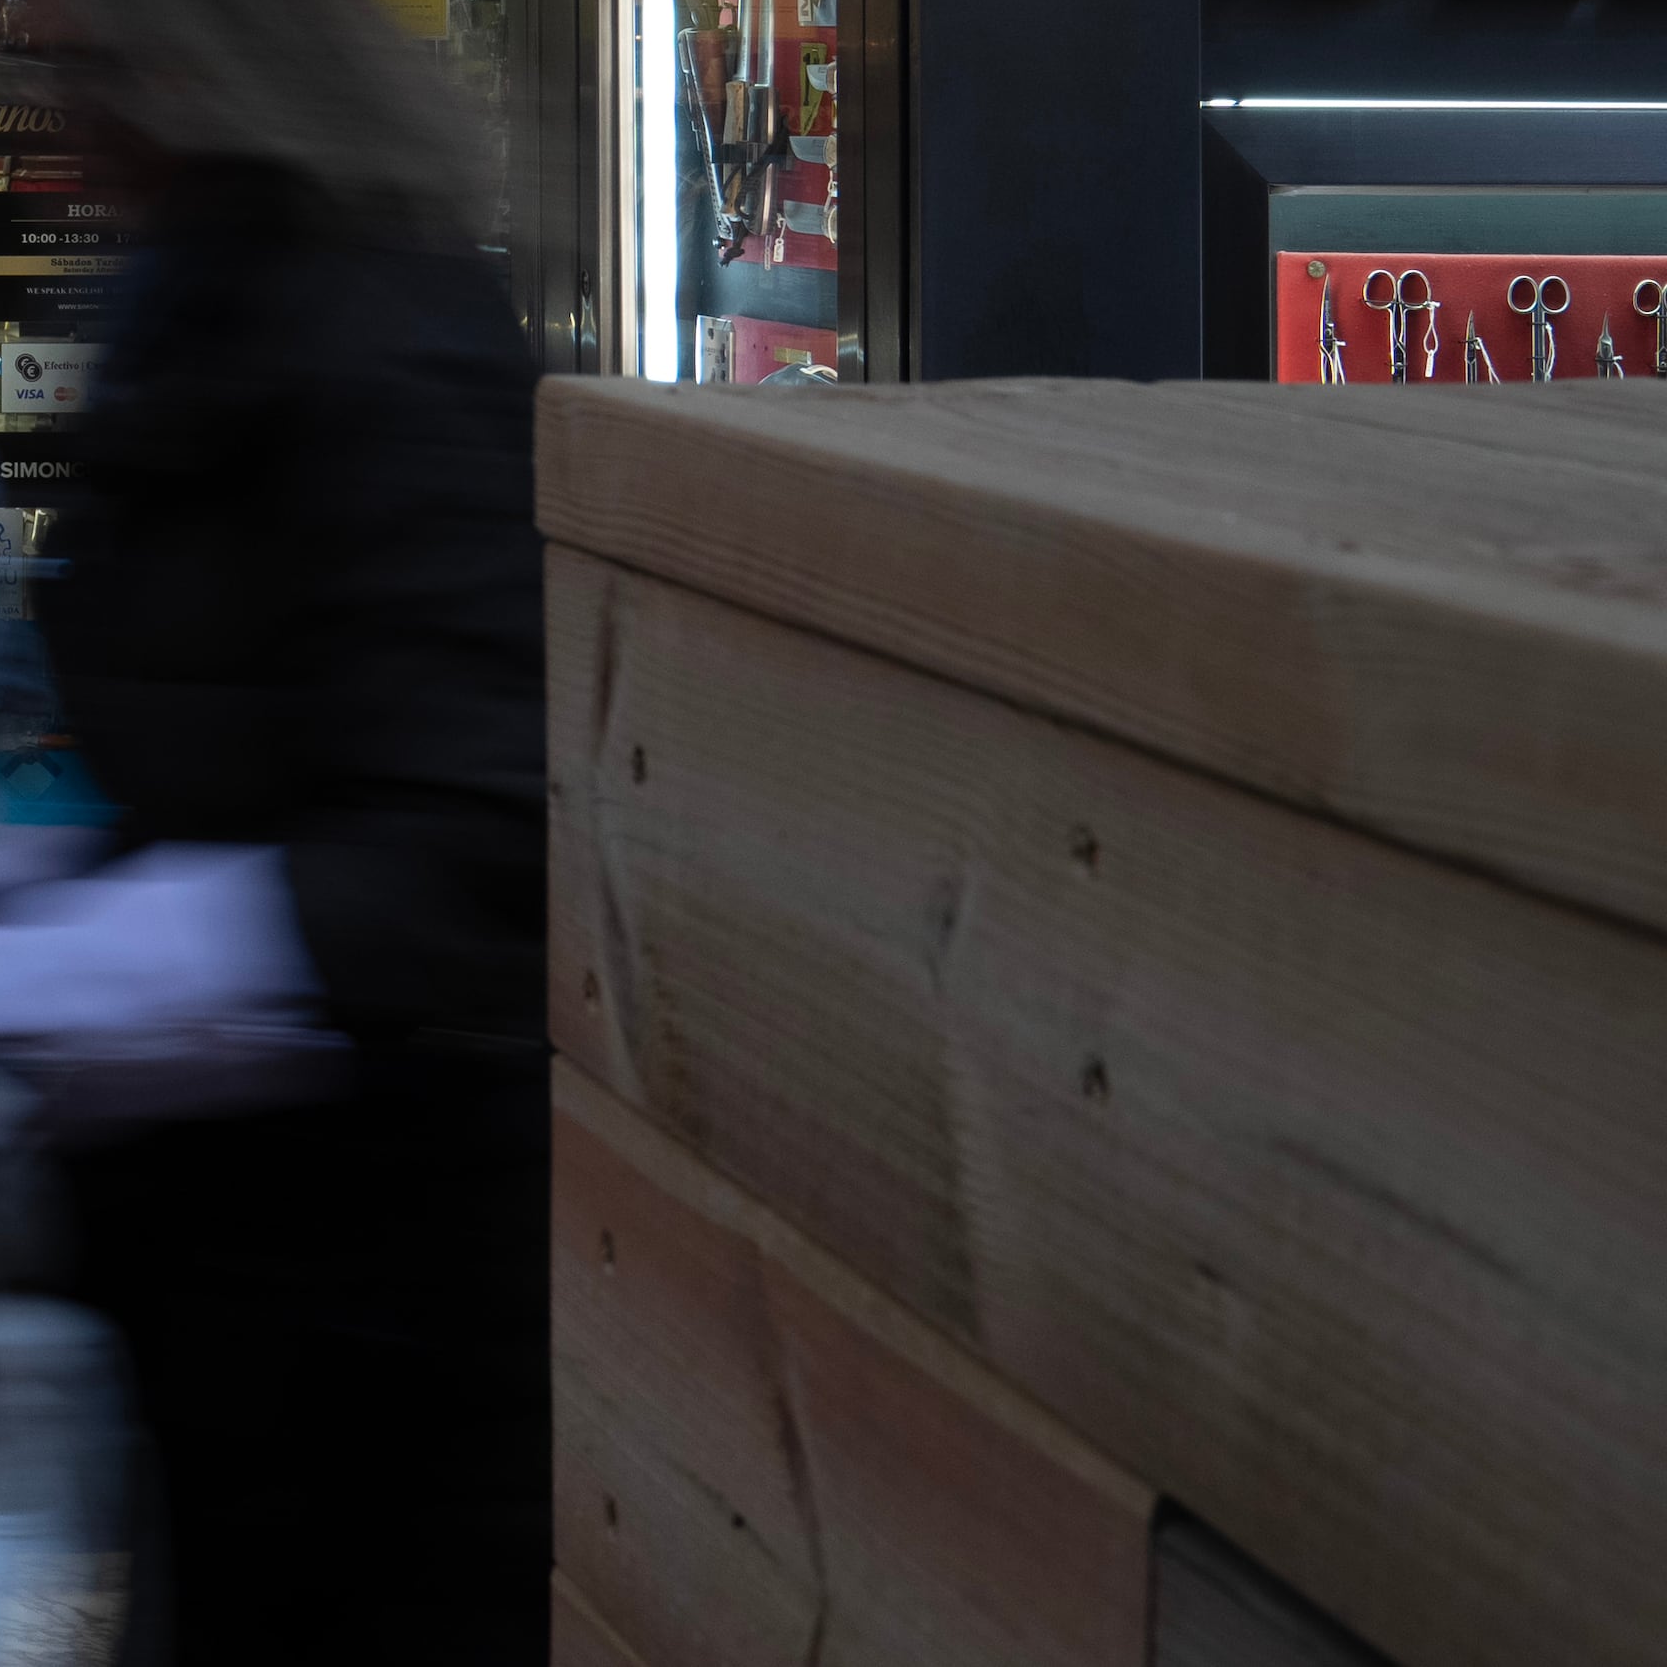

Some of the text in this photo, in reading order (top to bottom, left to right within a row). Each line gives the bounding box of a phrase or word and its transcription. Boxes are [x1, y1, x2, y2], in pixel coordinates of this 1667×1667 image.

[67, 204, 117, 218] HORA
[20, 233, 57, 244] 10:00
[51, 257, 92, 267] Sábados
[26, 287, 40, 296] WE
[40, 287, 68, 296] SPEAK
[43, 361, 80, 371] Efectivo
[15, 388, 45, 400] VISA
